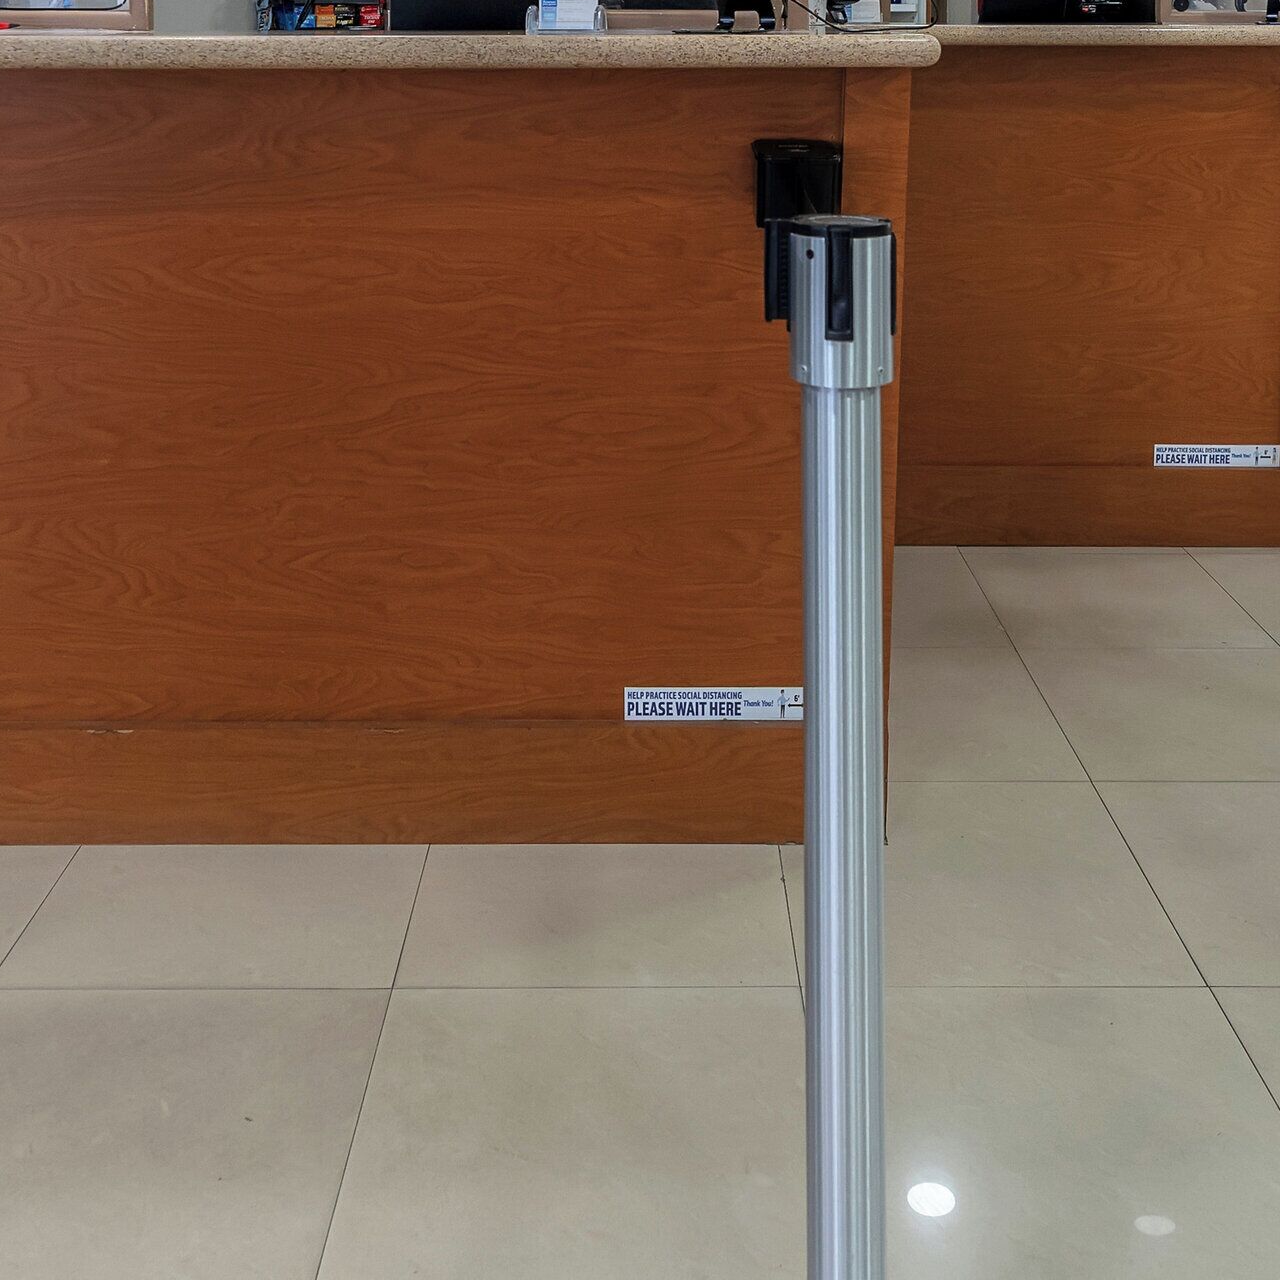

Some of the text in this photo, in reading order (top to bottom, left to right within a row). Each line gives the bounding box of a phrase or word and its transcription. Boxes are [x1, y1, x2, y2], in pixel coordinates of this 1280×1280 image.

[1156, 454, 1230, 464] PLEASE WAIT HERE
[627, 691, 742, 700] HELP PRACTICE SOCIAL DISTANCING
[627, 701, 742, 717] PLEASE WAIT HERE
